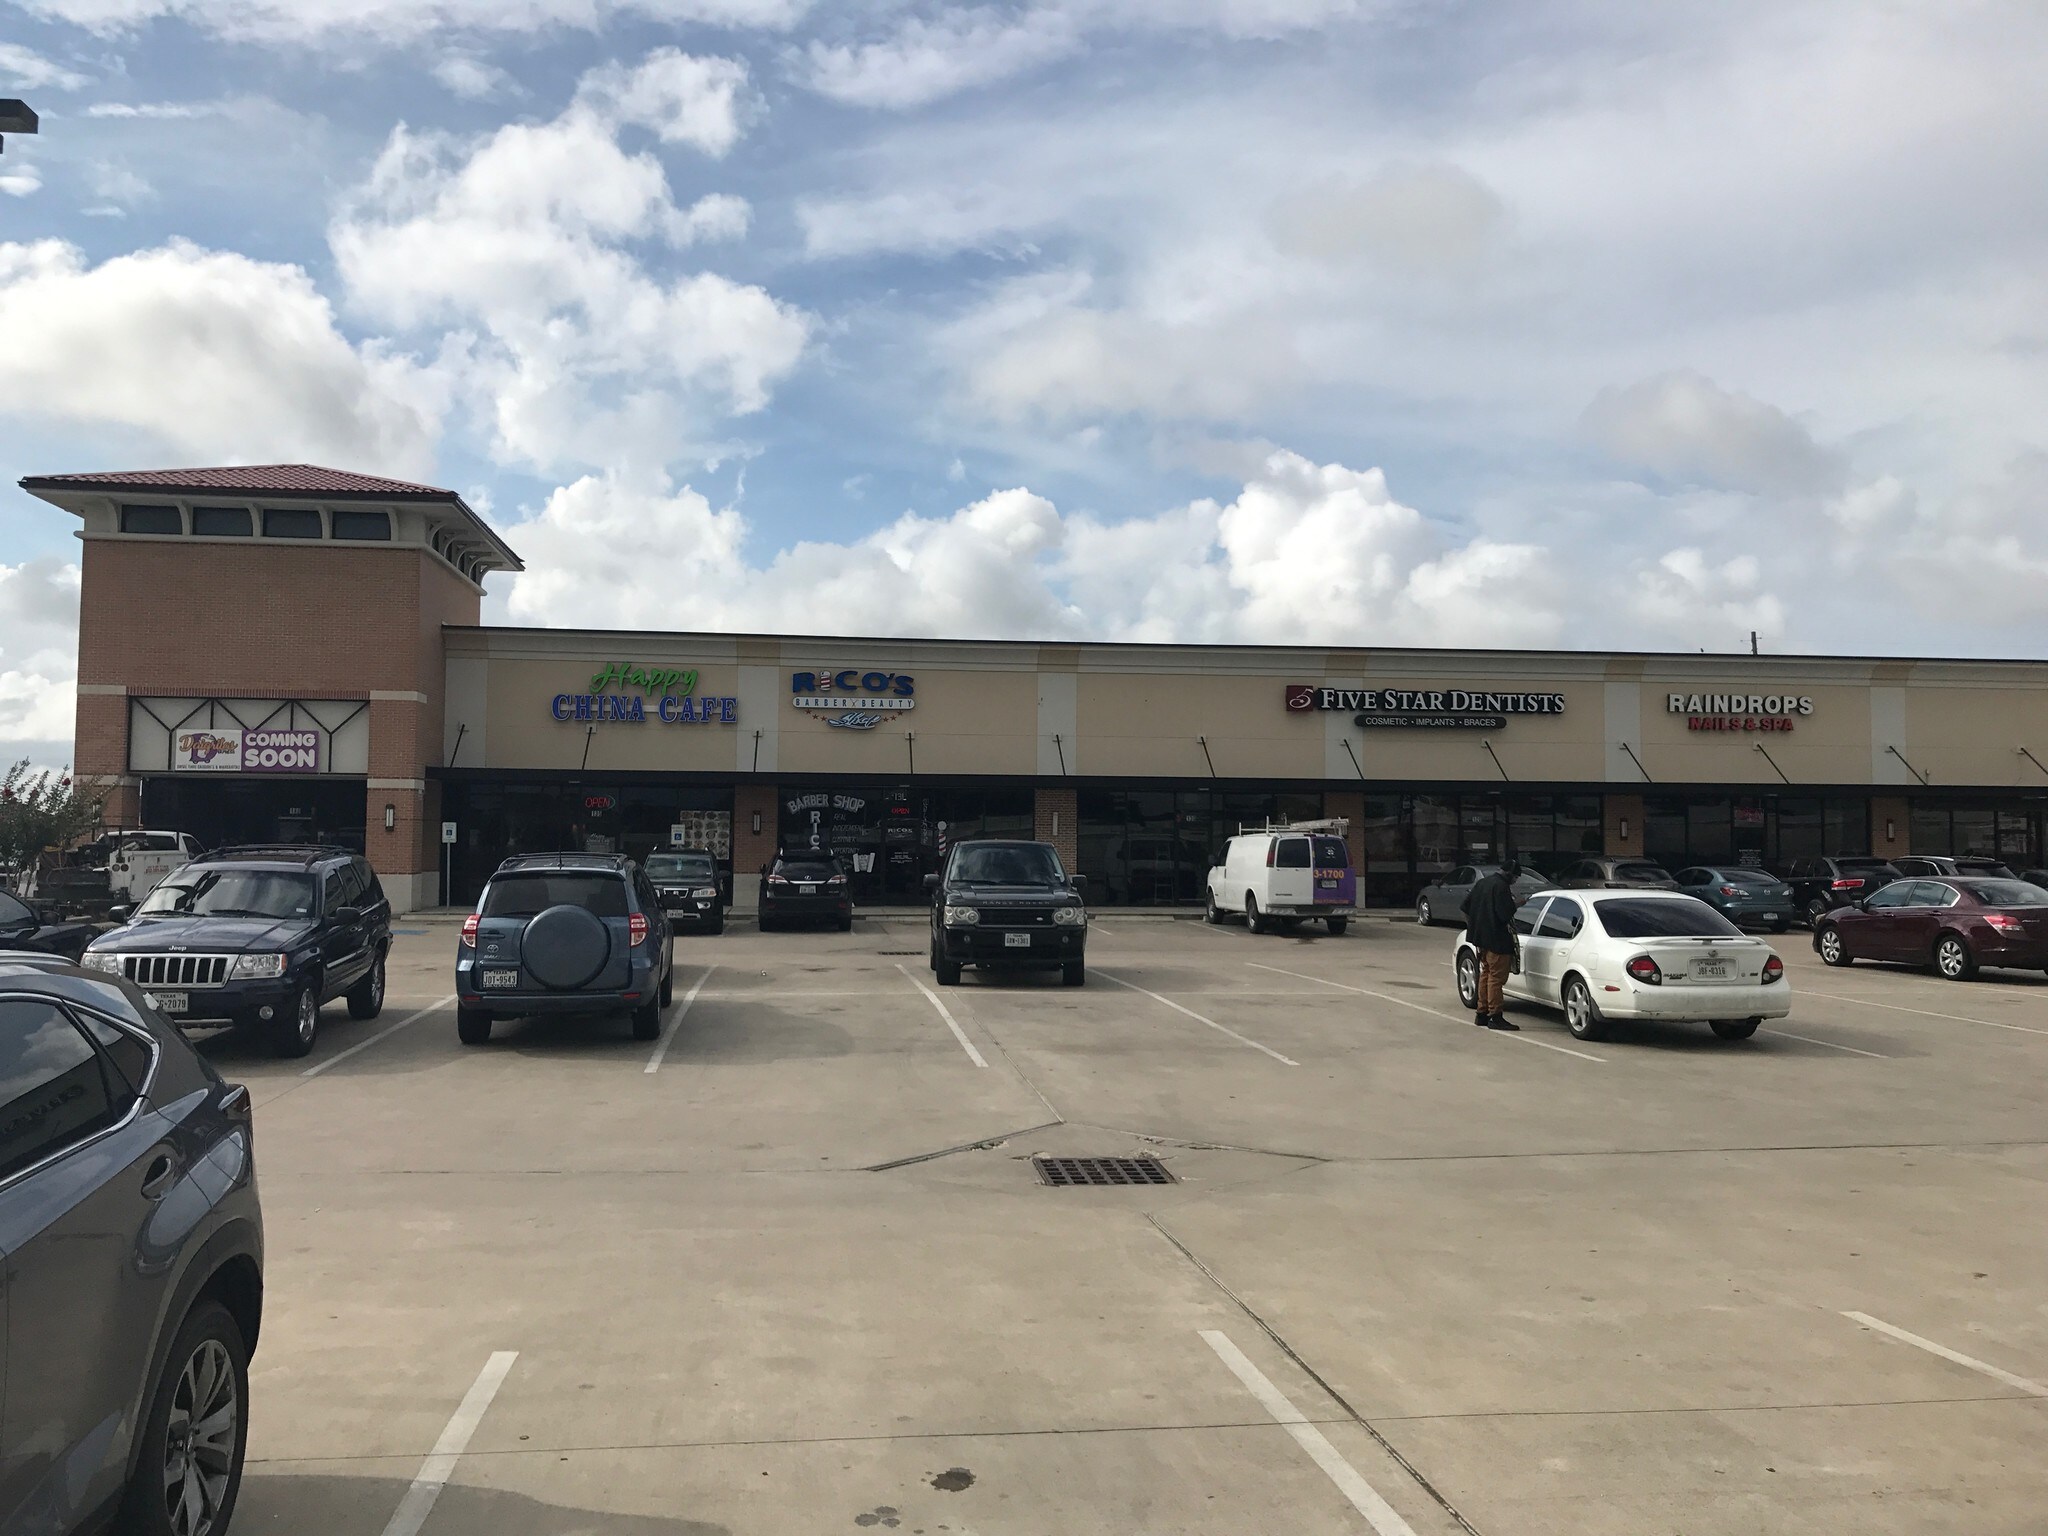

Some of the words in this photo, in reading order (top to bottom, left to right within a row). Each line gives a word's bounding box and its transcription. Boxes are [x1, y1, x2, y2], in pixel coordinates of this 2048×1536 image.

[590, 661, 698, 696] Happy
[552, 694, 646, 721] CHINA
[659, 696, 737, 723] CAFE
[795, 698, 847, 707] BARBER
[861, 699, 912, 708] BEAUTY
[1321, 689, 1377, 709] FIVE
[1384, 690, 1444, 711] STAR
[1450, 691, 1566, 713] DENTISTS
[1669, 694, 1814, 715] RAINDROPS
[1365, 717, 1408, 726] COSMETIC
[1415, 718, 1455, 726] IMPLANTS
[1464, 718, 1496, 726] BRACES
[1689, 717, 1742, 730] NAILS
[1745, 718, 1756, 730] &
[1760, 718, 1794, 731] SPA
[245, 733, 316, 747] COMING
[244, 749, 316, 768] SOON
[585, 797, 610, 808] OPEN
[787, 794, 829, 815] BARBER
[833, 795, 866, 813] SHOP
[809, 811, 821, 850] RIC
[1313, 869, 1345, 878] 3-1700
